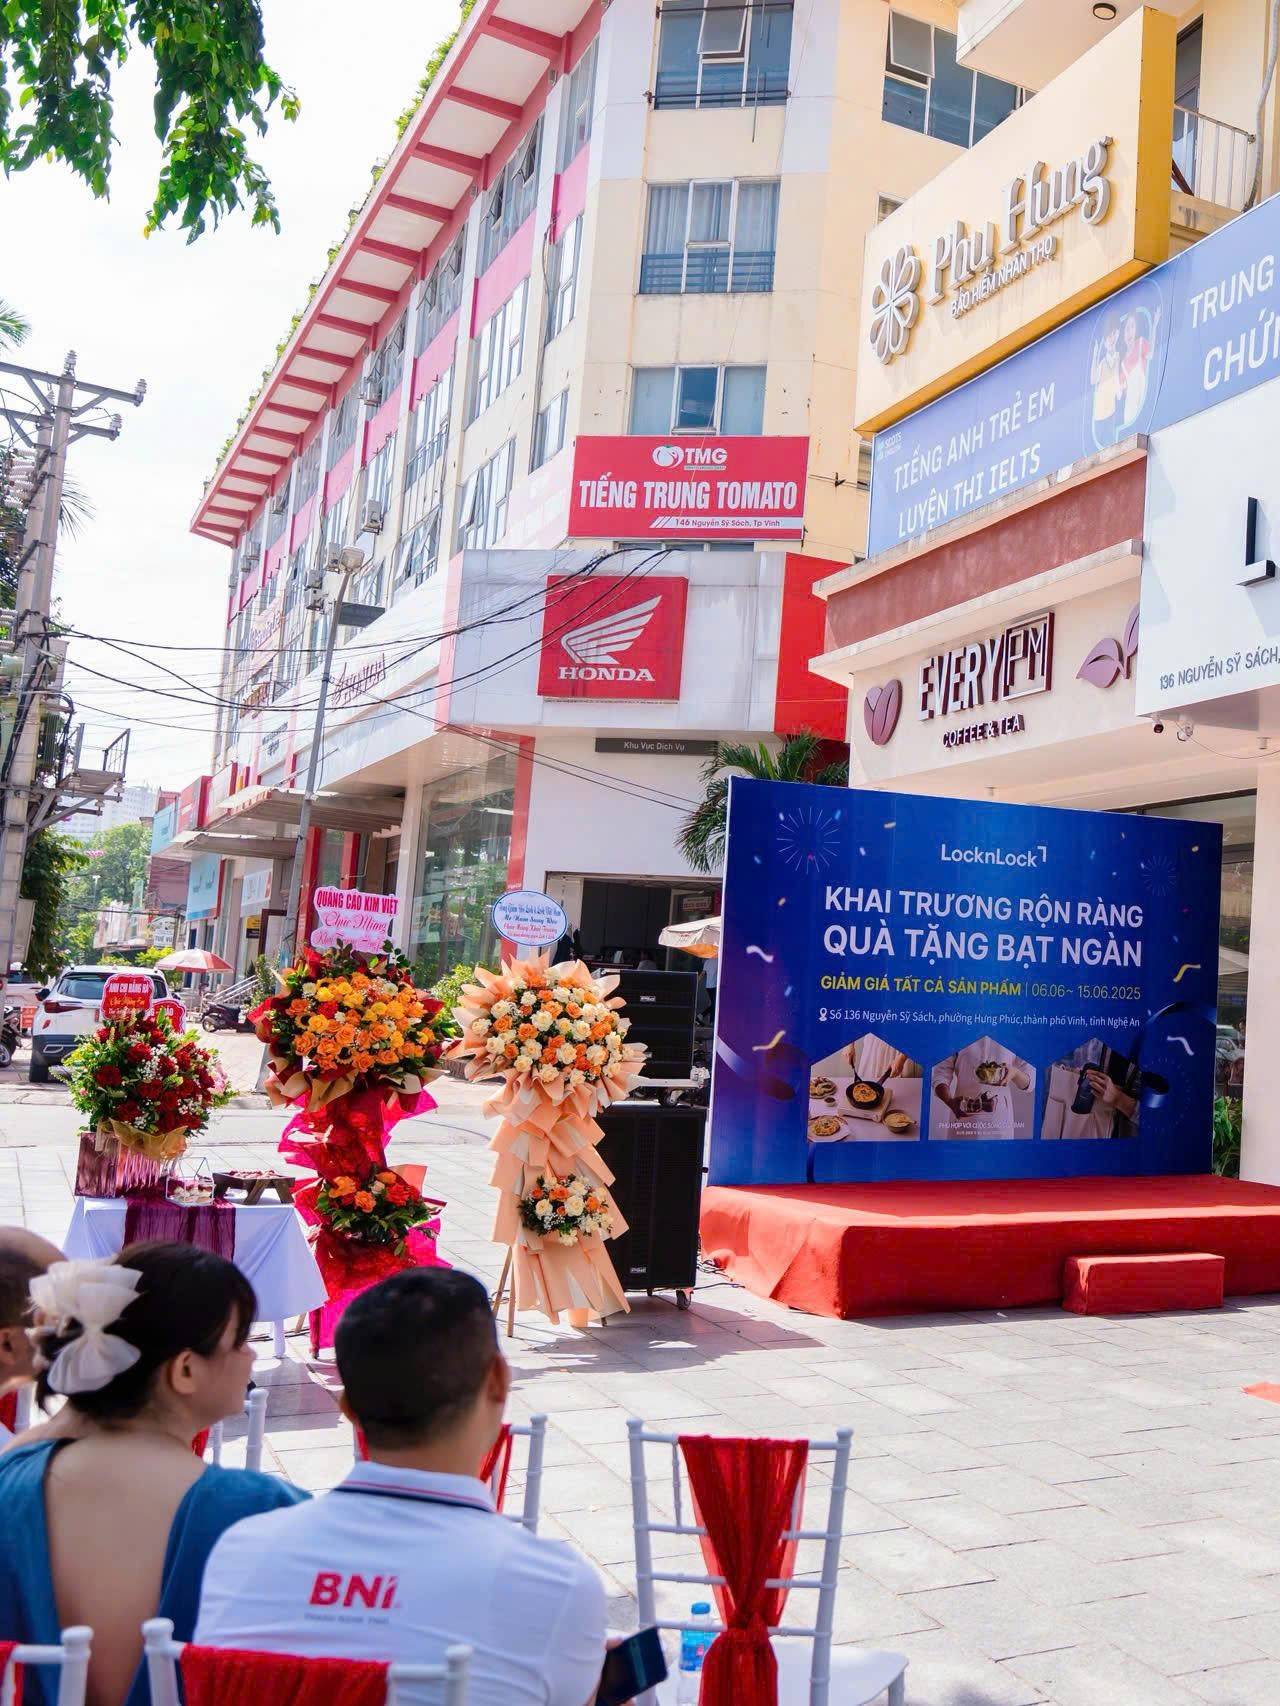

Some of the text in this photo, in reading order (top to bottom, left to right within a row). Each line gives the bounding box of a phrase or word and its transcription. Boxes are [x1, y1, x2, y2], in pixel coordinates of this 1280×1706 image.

[1190, 255, 1275, 328] TRUNG
[894, 383, 1054, 493] TIẾNG ANH TRẺ EM
[685, 447, 728, 464] TMG
[579, 472, 798, 510] TIẾNG TRUNG TOMATO
[954, 471, 984, 510] THI
[989, 443, 1041, 494] IELTS
[675, 518, 690, 527] 146
[765, 519, 780, 527] Vinh
[558, 667, 655, 681] HONDA
[1160, 674, 1174, 690] 136
[1178, 655, 1222, 686] NGUYỄN
[1226, 652, 1241, 673] SỸ
[1245, 646, 1280, 669] SÁCH,
[624, 741, 639, 750] Khu
[943, 713, 1025, 748] COFFEE & TEA
[941, 844, 1037, 868] LocknLock
[364, 895, 379, 912] KIM
[825, 885, 1143, 928] KHAI TRƯƠNG RỘN RÀNG
[824, 919, 1142, 969] QUÀ TẶNG BẠT NGÀN
[820, 971, 860, 990] GIẢM
[864, 973, 889, 991] GIÁ
[894, 975, 920, 992] TẤT
[923, 976, 944, 993] CẢ
[948, 977, 977, 994] SẢN
[980, 978, 1021, 995] PHẨM
[1078, 985, 1141, 1000] 15.06.2025
[829, 1009, 842, 1020] Số
[844, 1009, 860, 1020] 136
[862, 1009, 897, 1023] Nguyễn
[899, 1010, 910, 1023] Sỹ
[912, 1010, 937, 1023] Sách,
[938, 1011, 972, 1025] phường
[974, 1014, 997, 1026] Hưng
[1050, 1014, 1065, 1026] phố
[1067, 1015, 1088, 1027] Vinh,
[1108, 1017, 1128, 1028] Nghệ
[1129, 1017, 1140, 1026] An
